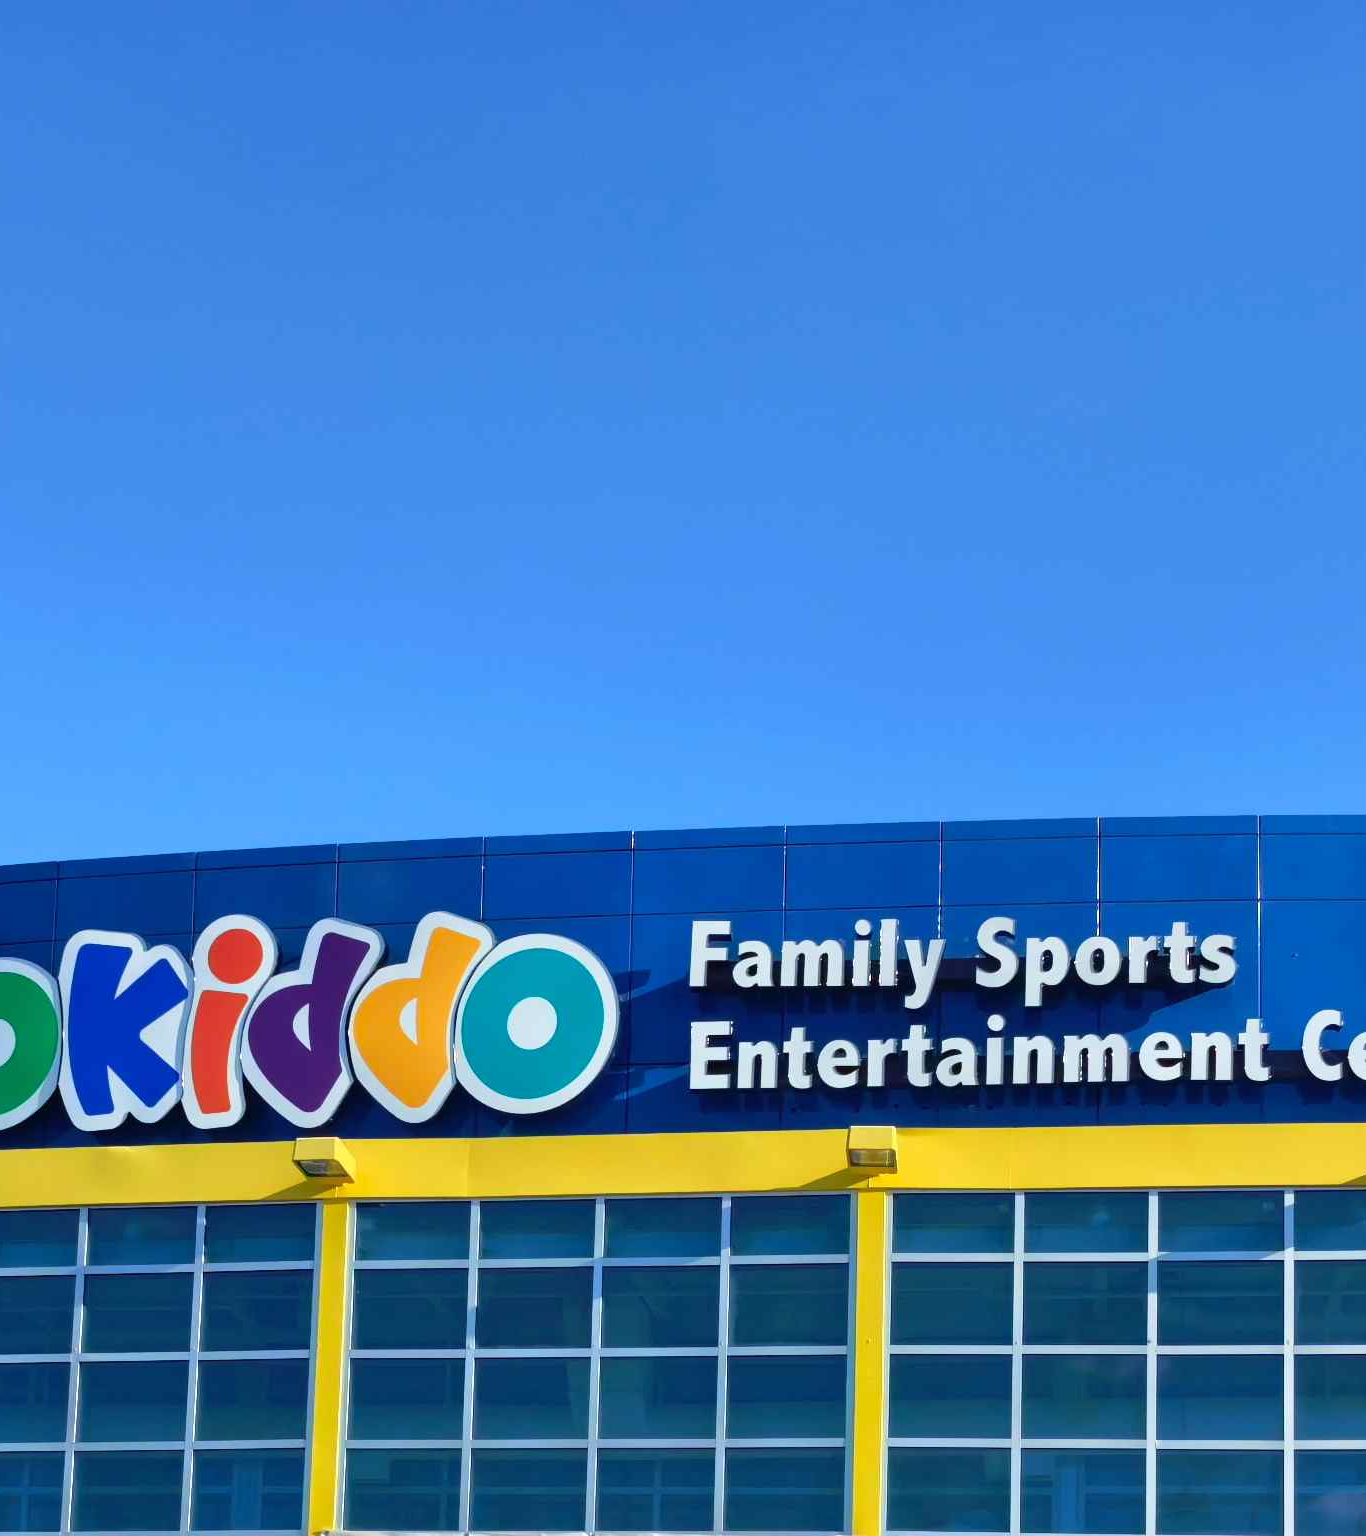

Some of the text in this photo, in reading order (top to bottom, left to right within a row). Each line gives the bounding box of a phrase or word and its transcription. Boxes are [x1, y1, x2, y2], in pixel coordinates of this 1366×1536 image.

[688, 916, 1238, 1008] Family Sports
[688, 1014, 1273, 1089] Entertainment
